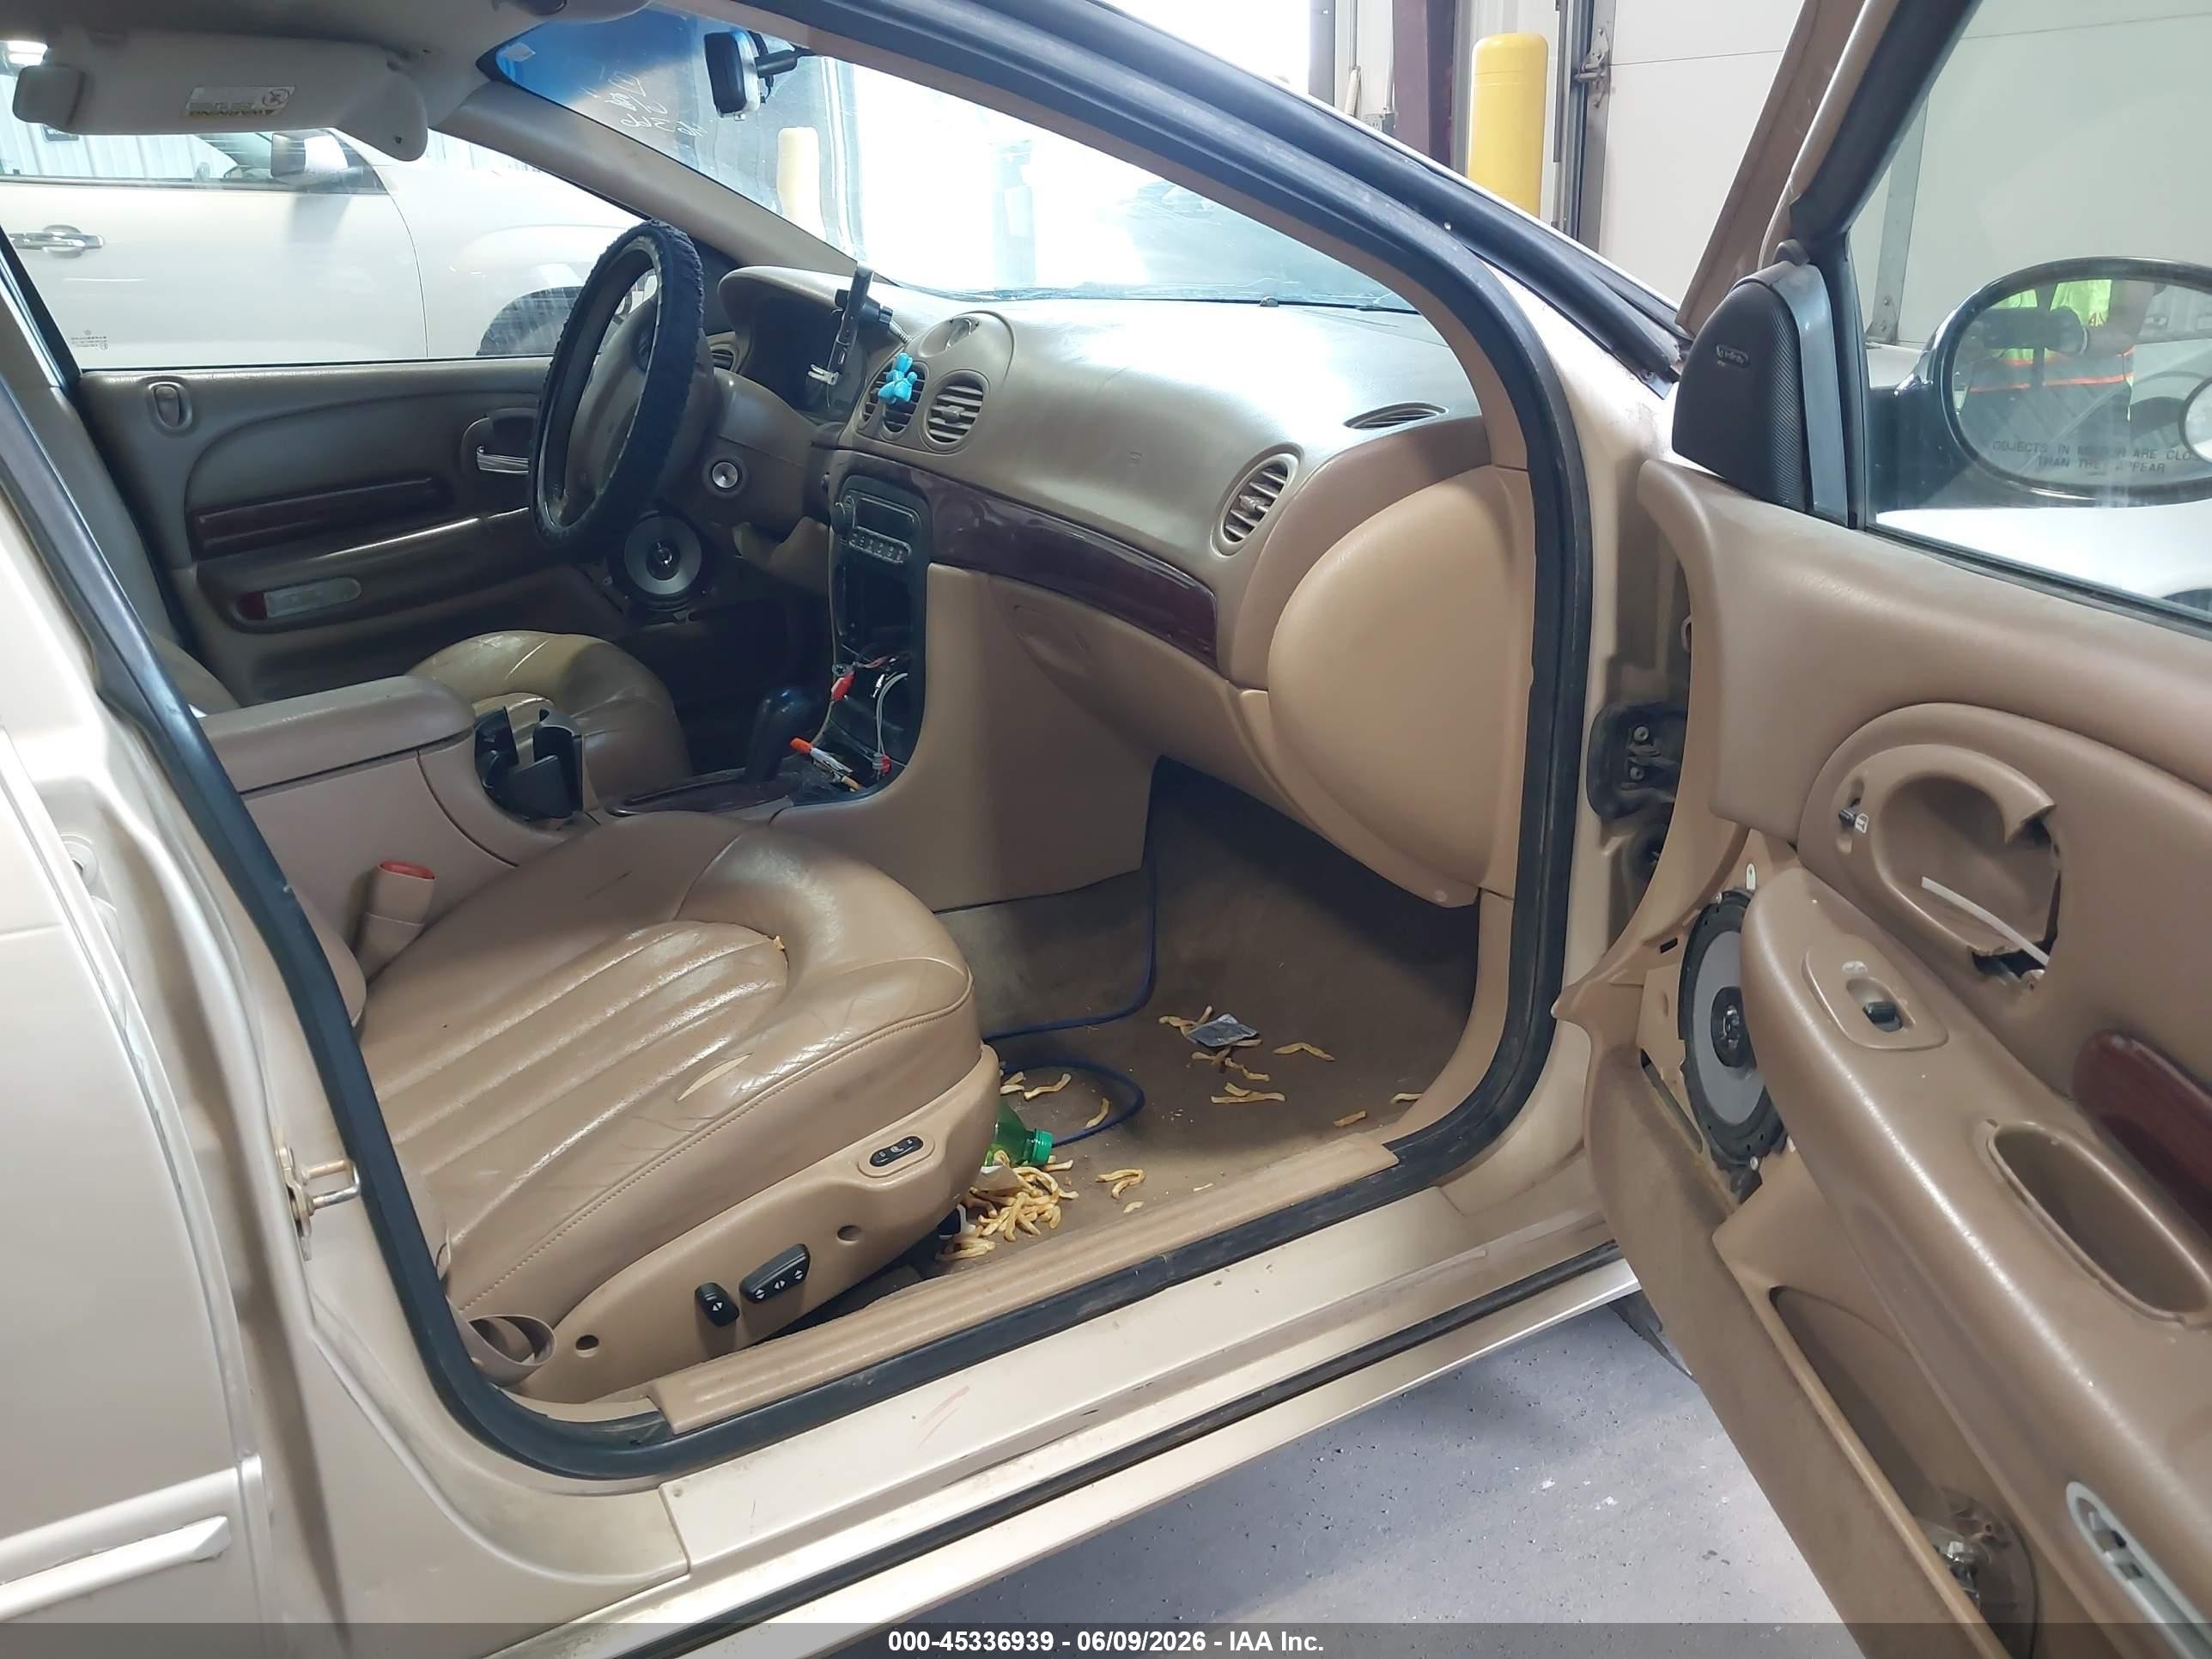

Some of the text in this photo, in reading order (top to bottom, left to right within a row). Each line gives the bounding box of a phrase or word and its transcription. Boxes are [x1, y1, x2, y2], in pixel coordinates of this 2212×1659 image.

[1992, 440, 2048, 453] OBJECTS
[2057, 443, 2069, 454] IN
[2133, 448, 2158, 460] ARE
[2039, 454, 2070, 468] THAN
